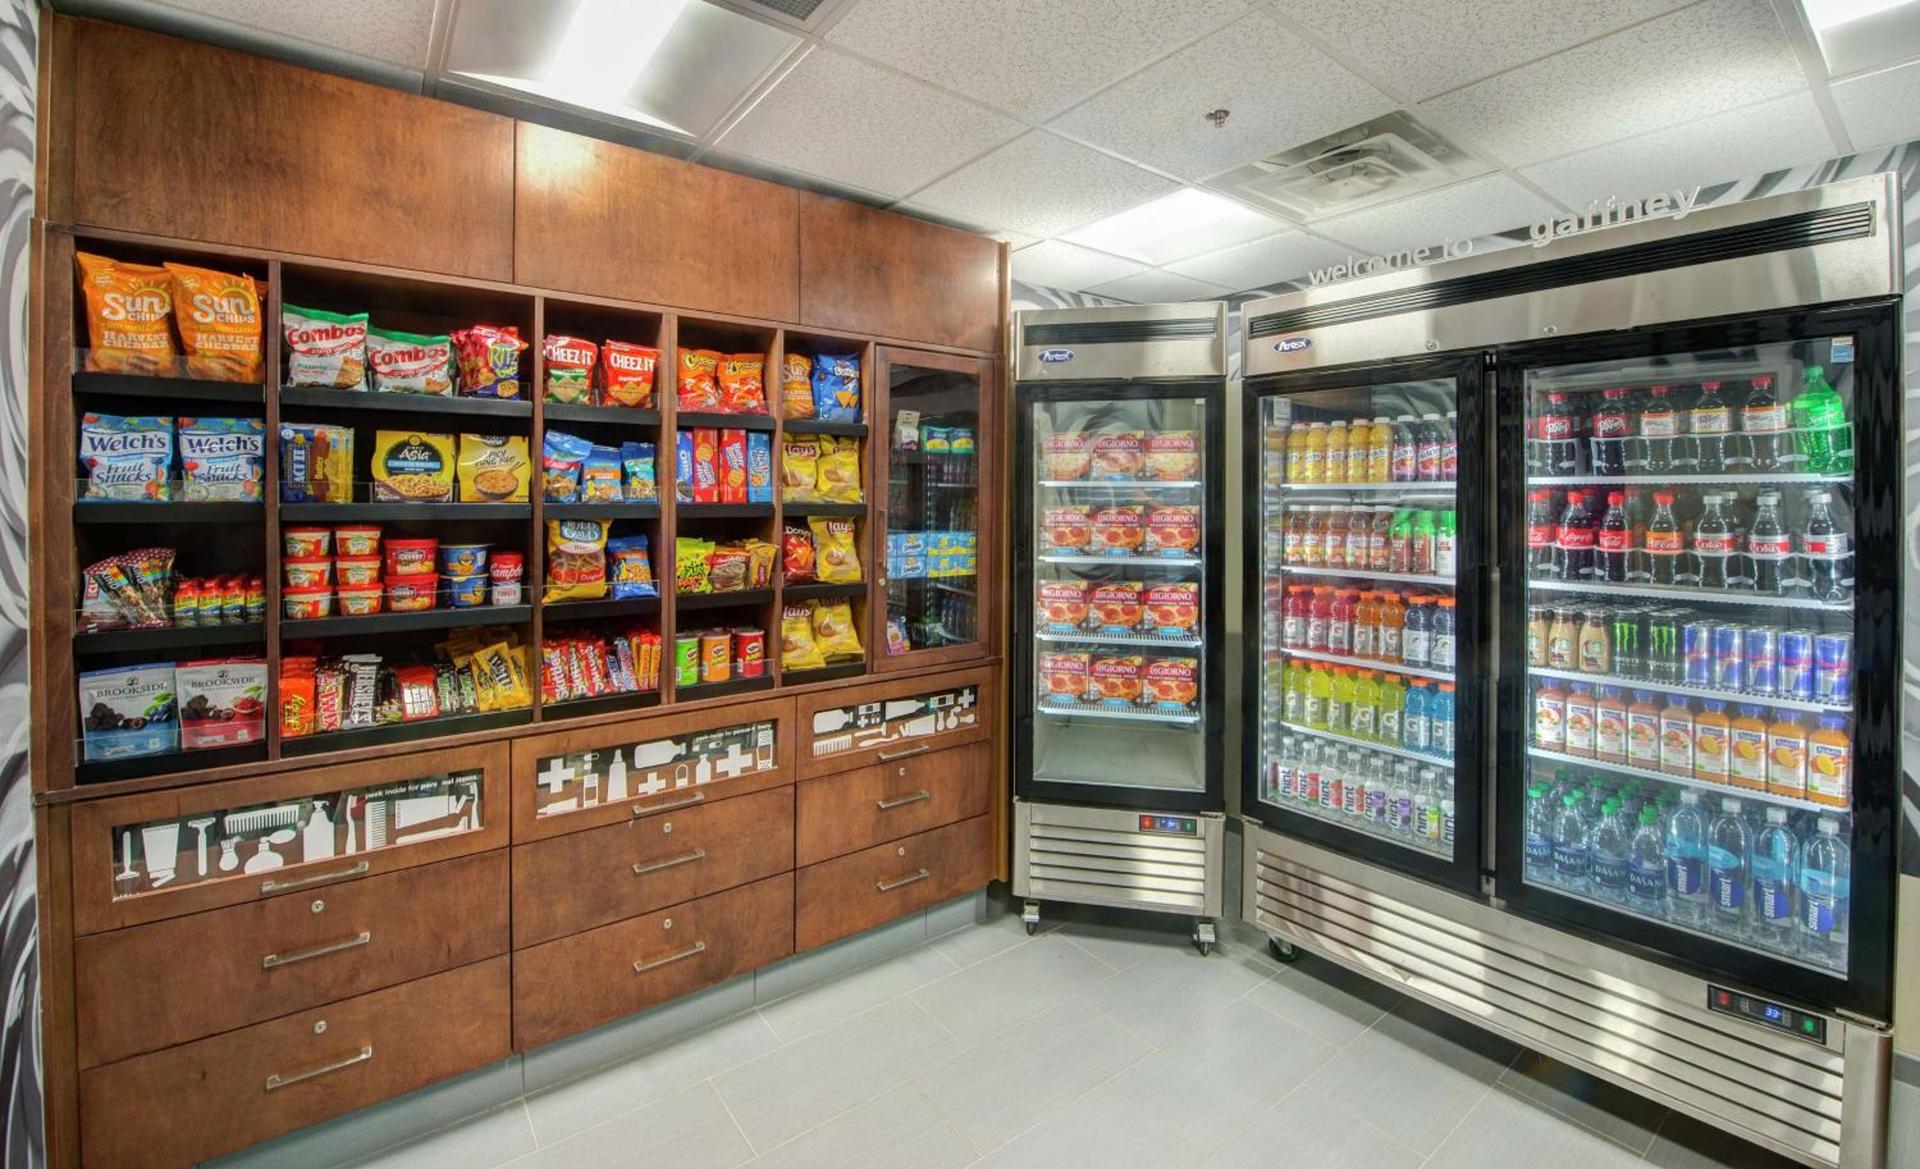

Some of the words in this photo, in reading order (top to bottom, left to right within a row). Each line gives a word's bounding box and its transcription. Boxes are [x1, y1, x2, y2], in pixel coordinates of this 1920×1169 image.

[1308, 243, 1432, 285] welcome
[1443, 239, 1473, 259] to
[1530, 184, 1701, 248] gaffney
[102, 292, 170, 321] Sun
[193, 293, 254, 323] Sun
[216, 313, 255, 323] CHIPS
[287, 323, 366, 345] Combos
[370, 346, 449, 367] Combos
[88, 434, 166, 453] Welch's
[186, 437, 260, 454] Welch's
[107, 462, 145, 473] Fruit
[207, 463, 241, 474] Fruit
[95, 472, 152, 485] Snacks
[197, 472, 248, 484] Snacks
[96, 682, 168, 698] BROOKSIDE
[191, 676, 256, 689] BROOKSIDE
[385, 787, 406, 795] inside
[1416, 806, 1427, 836] hint
[1676, 864, 1687, 894] smart
[1718, 877, 1731, 907] smart
[1762, 887, 1775, 918] smart
[1807, 900, 1818, 931] smart
